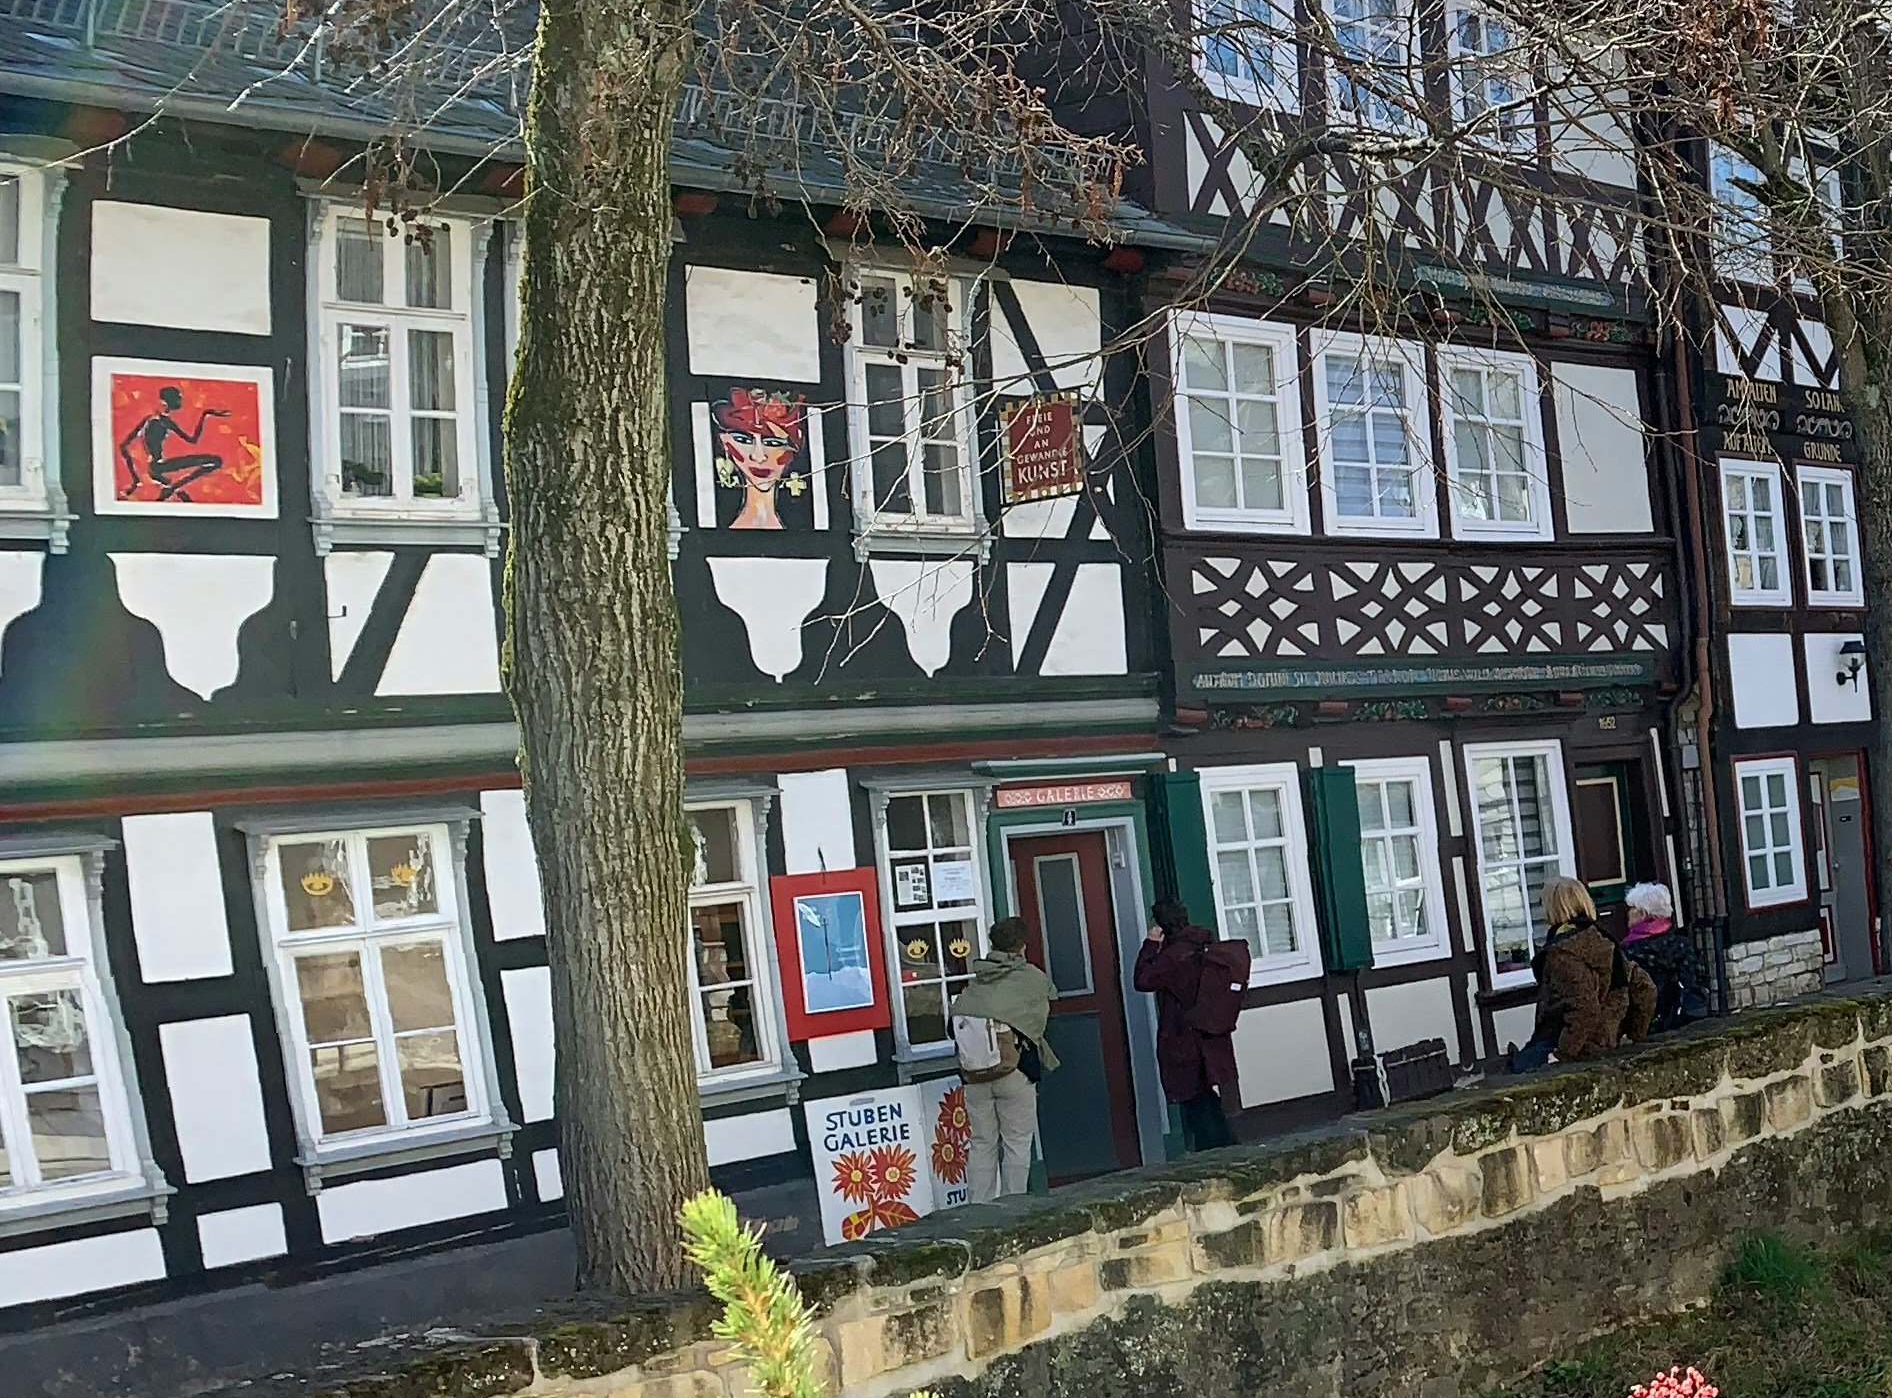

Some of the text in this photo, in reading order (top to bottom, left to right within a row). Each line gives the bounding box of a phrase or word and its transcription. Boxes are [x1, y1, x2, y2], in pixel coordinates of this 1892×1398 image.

[1821, 391, 1845, 413] LAN
[1033, 439, 1049, 450] AN
[1016, 446, 1068, 465] GEWANDE
[1018, 459, 1068, 484] KUNST
[1036, 786, 1095, 803] GALERIE
[825, 1103, 903, 1131] STUBEN
[824, 1123, 910, 1152] GALERIE
[946, 1188, 968, 1205] STU
